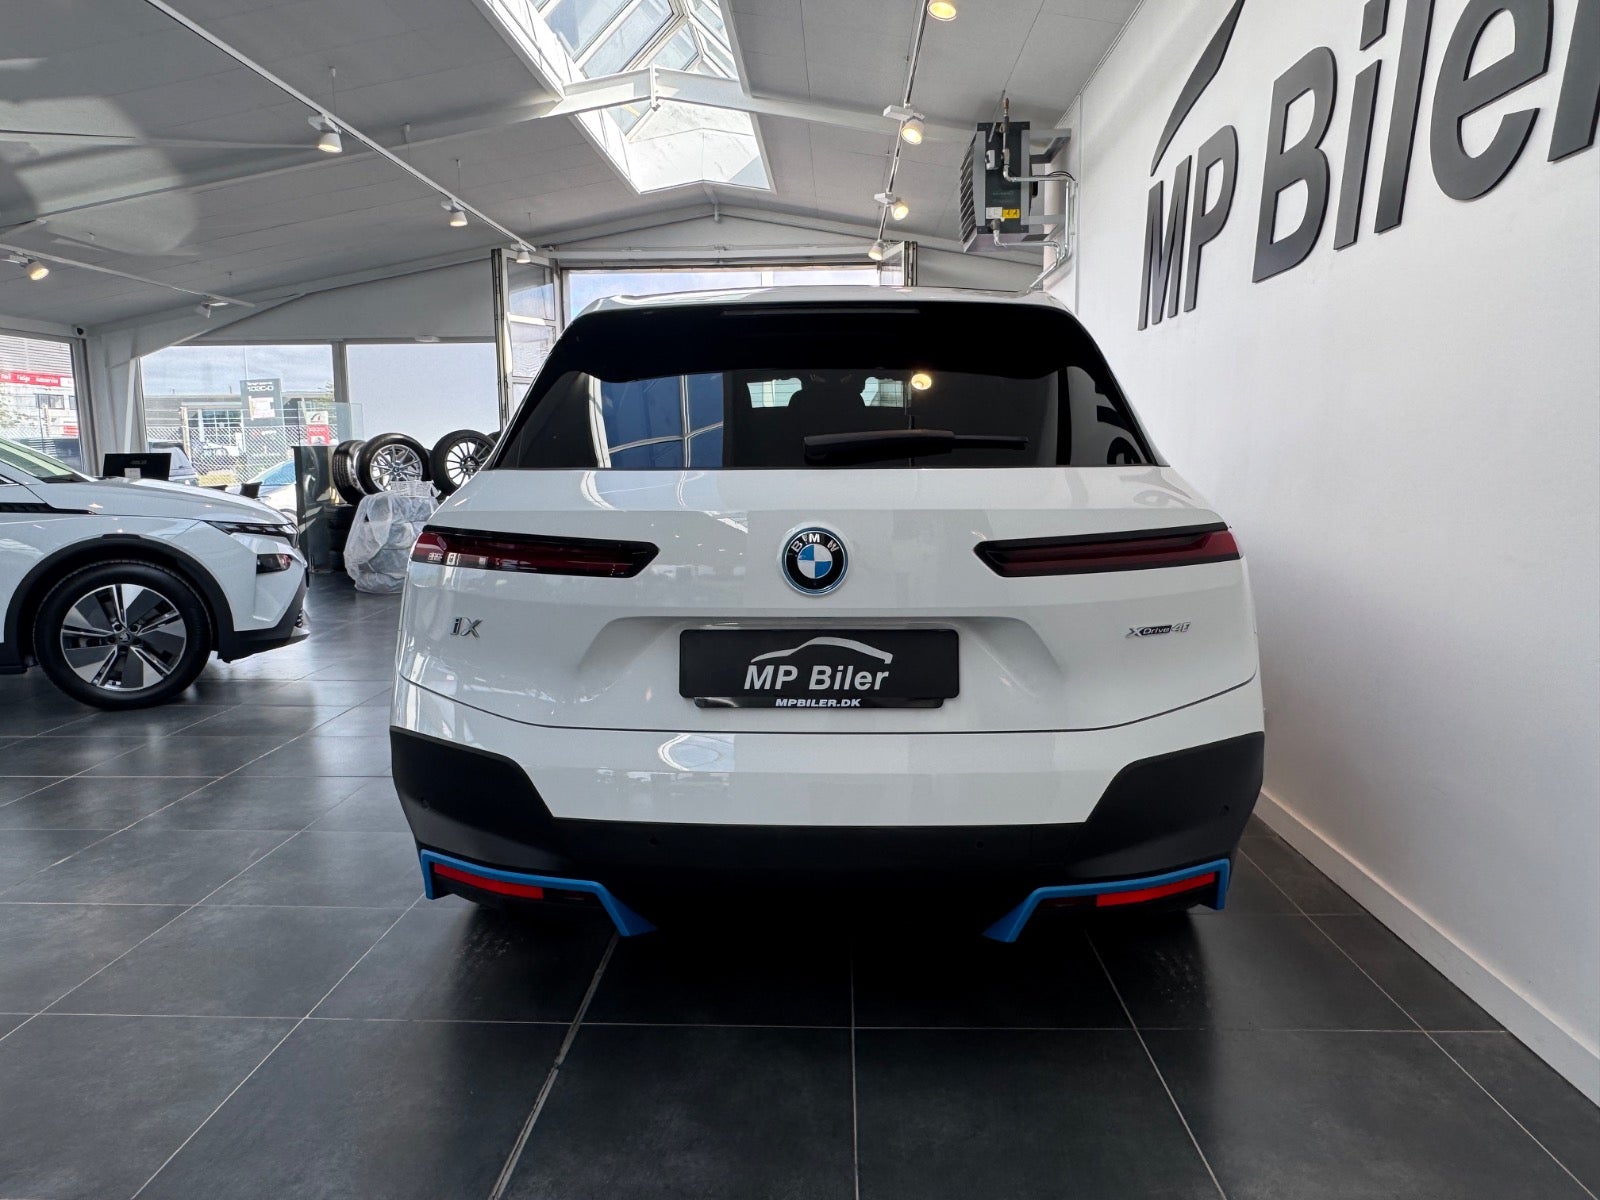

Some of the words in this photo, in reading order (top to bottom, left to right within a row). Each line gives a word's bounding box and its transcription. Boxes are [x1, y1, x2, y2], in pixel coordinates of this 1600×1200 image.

[1138, 125, 1239, 331] MP
[790, 532, 840, 553] BMW
[450, 616, 484, 640] iX
[743, 664, 798, 690] MP
[808, 664, 889, 690] Biler
[775, 698, 861, 707] MPBILER.DK
